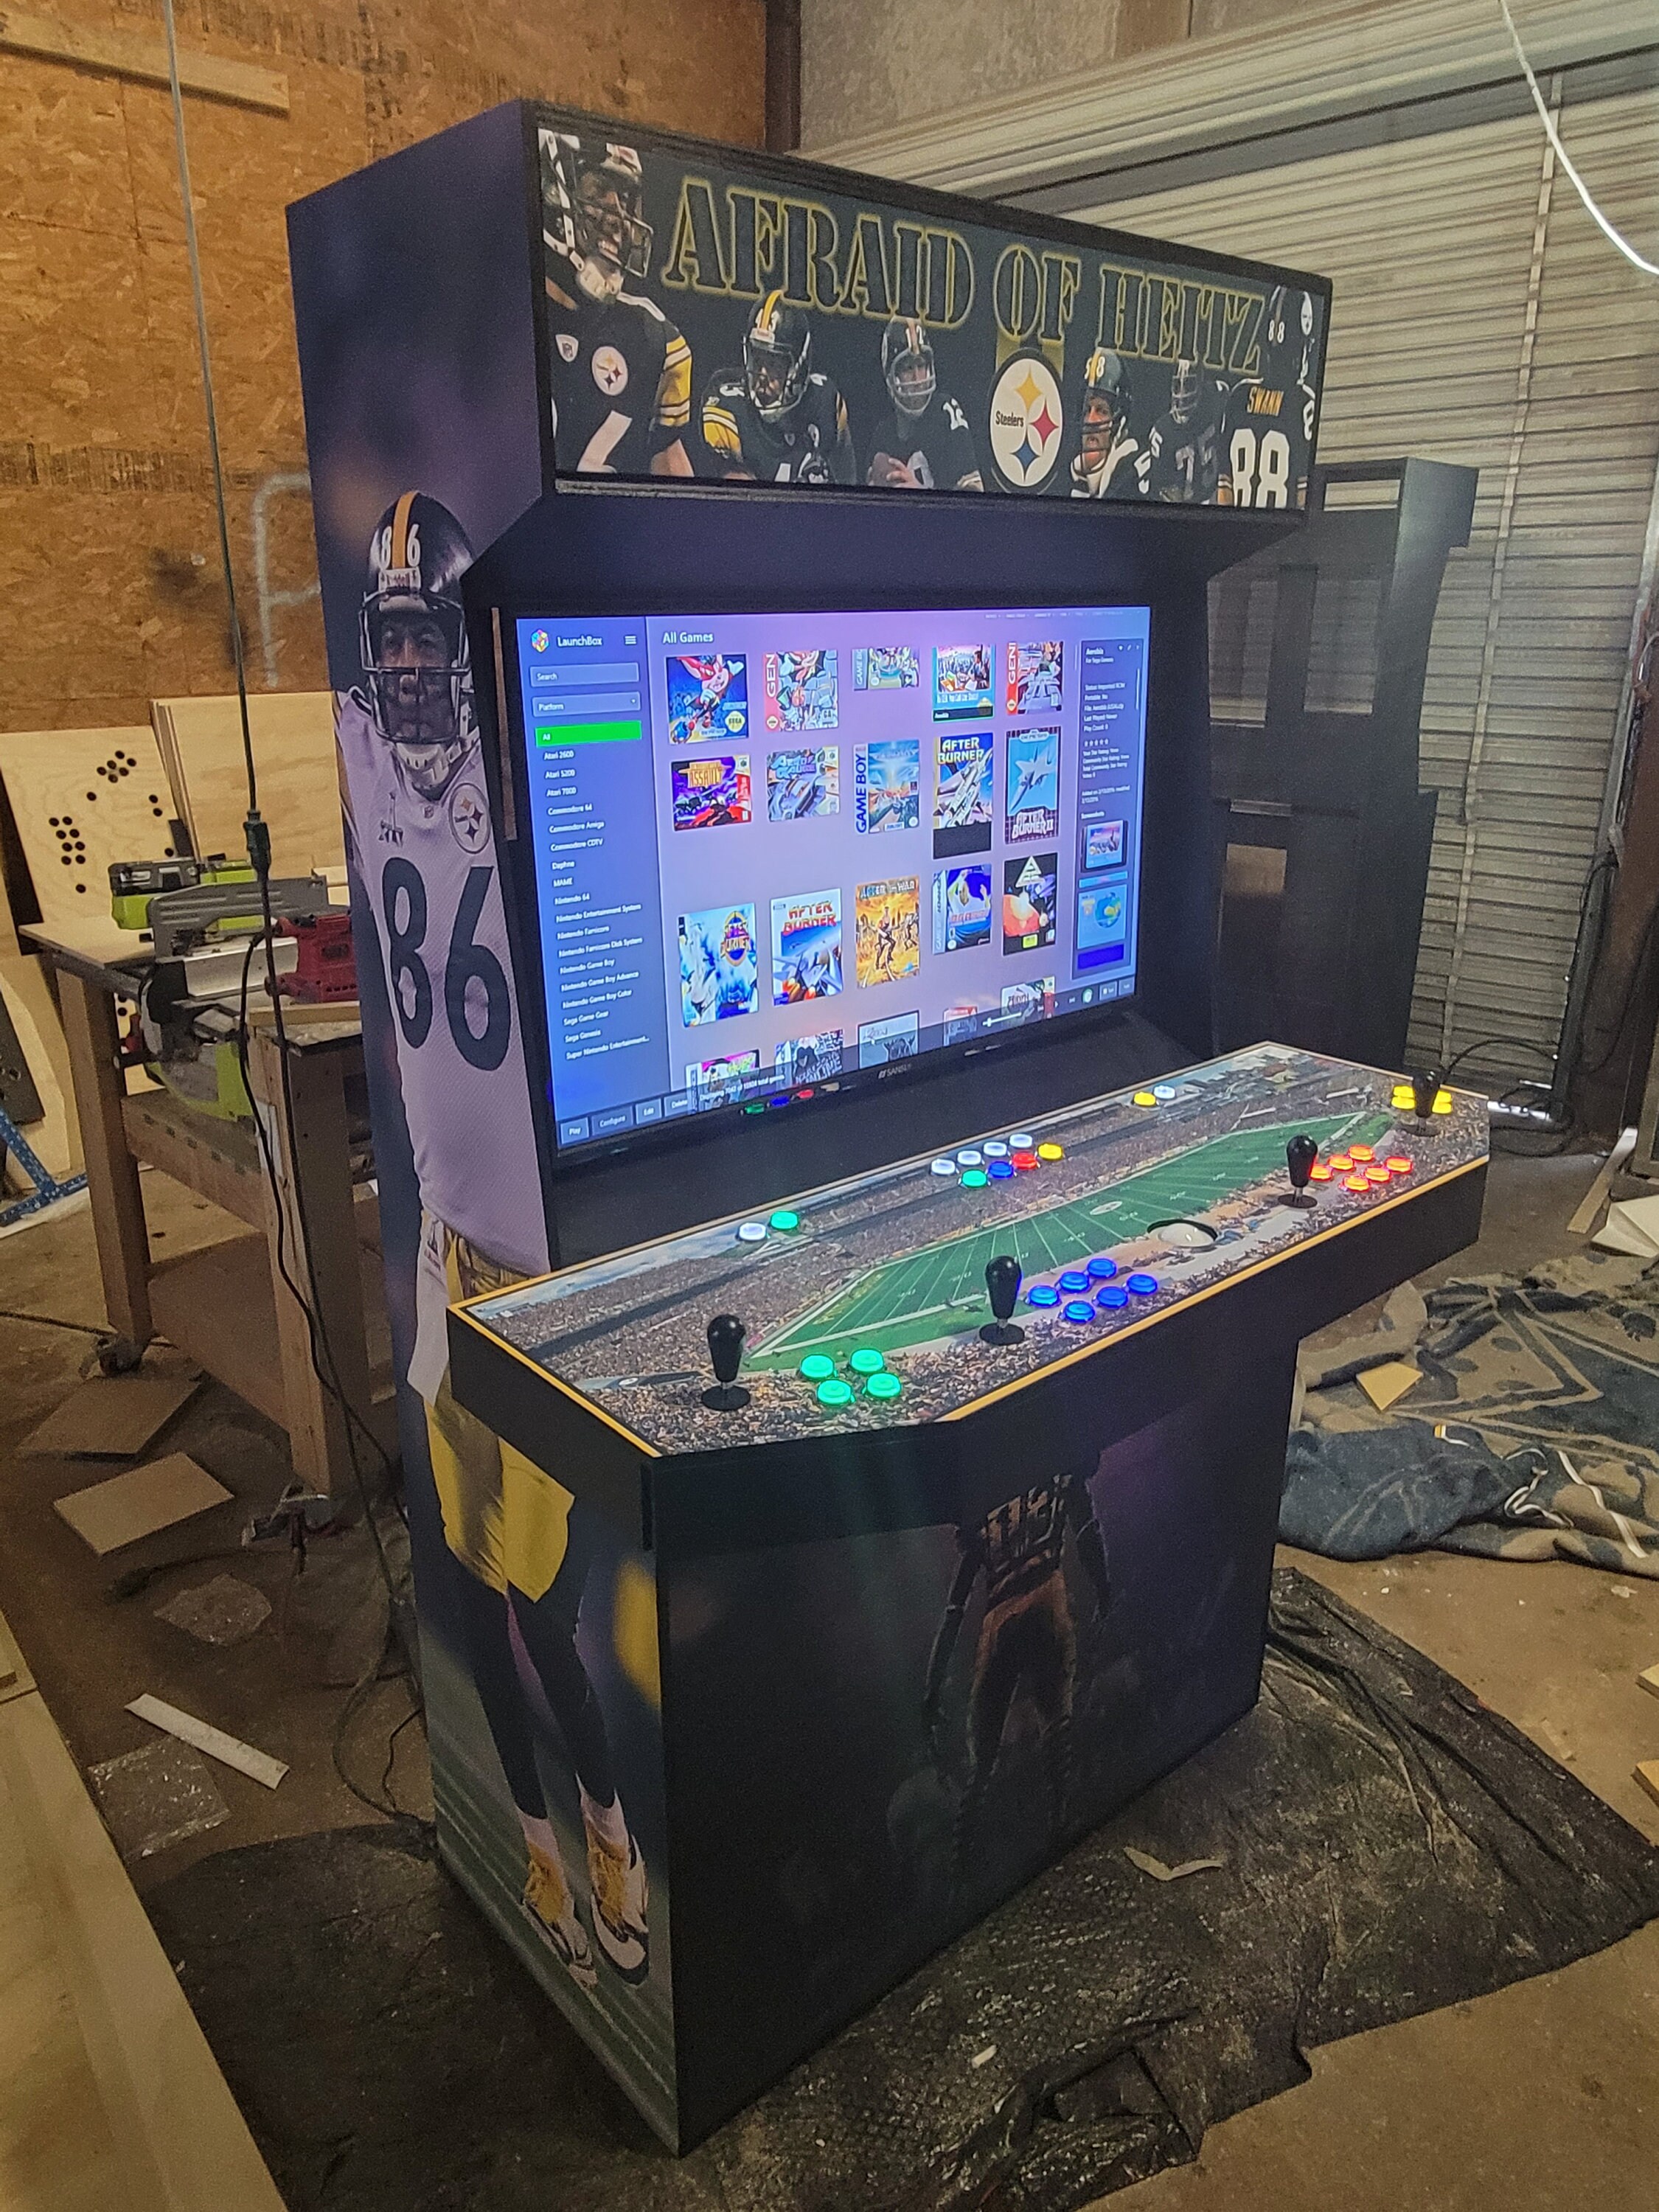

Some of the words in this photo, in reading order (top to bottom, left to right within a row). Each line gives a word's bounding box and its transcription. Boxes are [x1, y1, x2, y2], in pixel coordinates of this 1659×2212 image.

[663, 176, 975, 330] AFRAID
[993, 244, 1082, 341] OF
[1097, 264, 1267, 375] HEITZ
[1246, 386, 1284, 417] SWANN
[995, 410, 1025, 428] Steelers
[1229, 428, 1290, 508] 88
[378, 524, 421, 570] 86
[557, 635, 603, 647] LaunchBox
[662, 631, 678, 644] All
[679, 632, 714, 643] Games
[537, 672, 558, 681] Search
[542, 733, 551, 741] All
[942, 737, 979, 752] AFTER
[544, 751, 558, 760] Atari
[937, 748, 984, 765] BURNER
[546, 771, 560, 779] Atari
[855, 753, 866, 785] BOY
[546, 789, 561, 797] Atari
[855, 787, 866, 833] GAME
[788, 900, 833, 919] AFTER
[782, 914, 838, 936] BURNER
[381, 857, 512, 1071] 86
